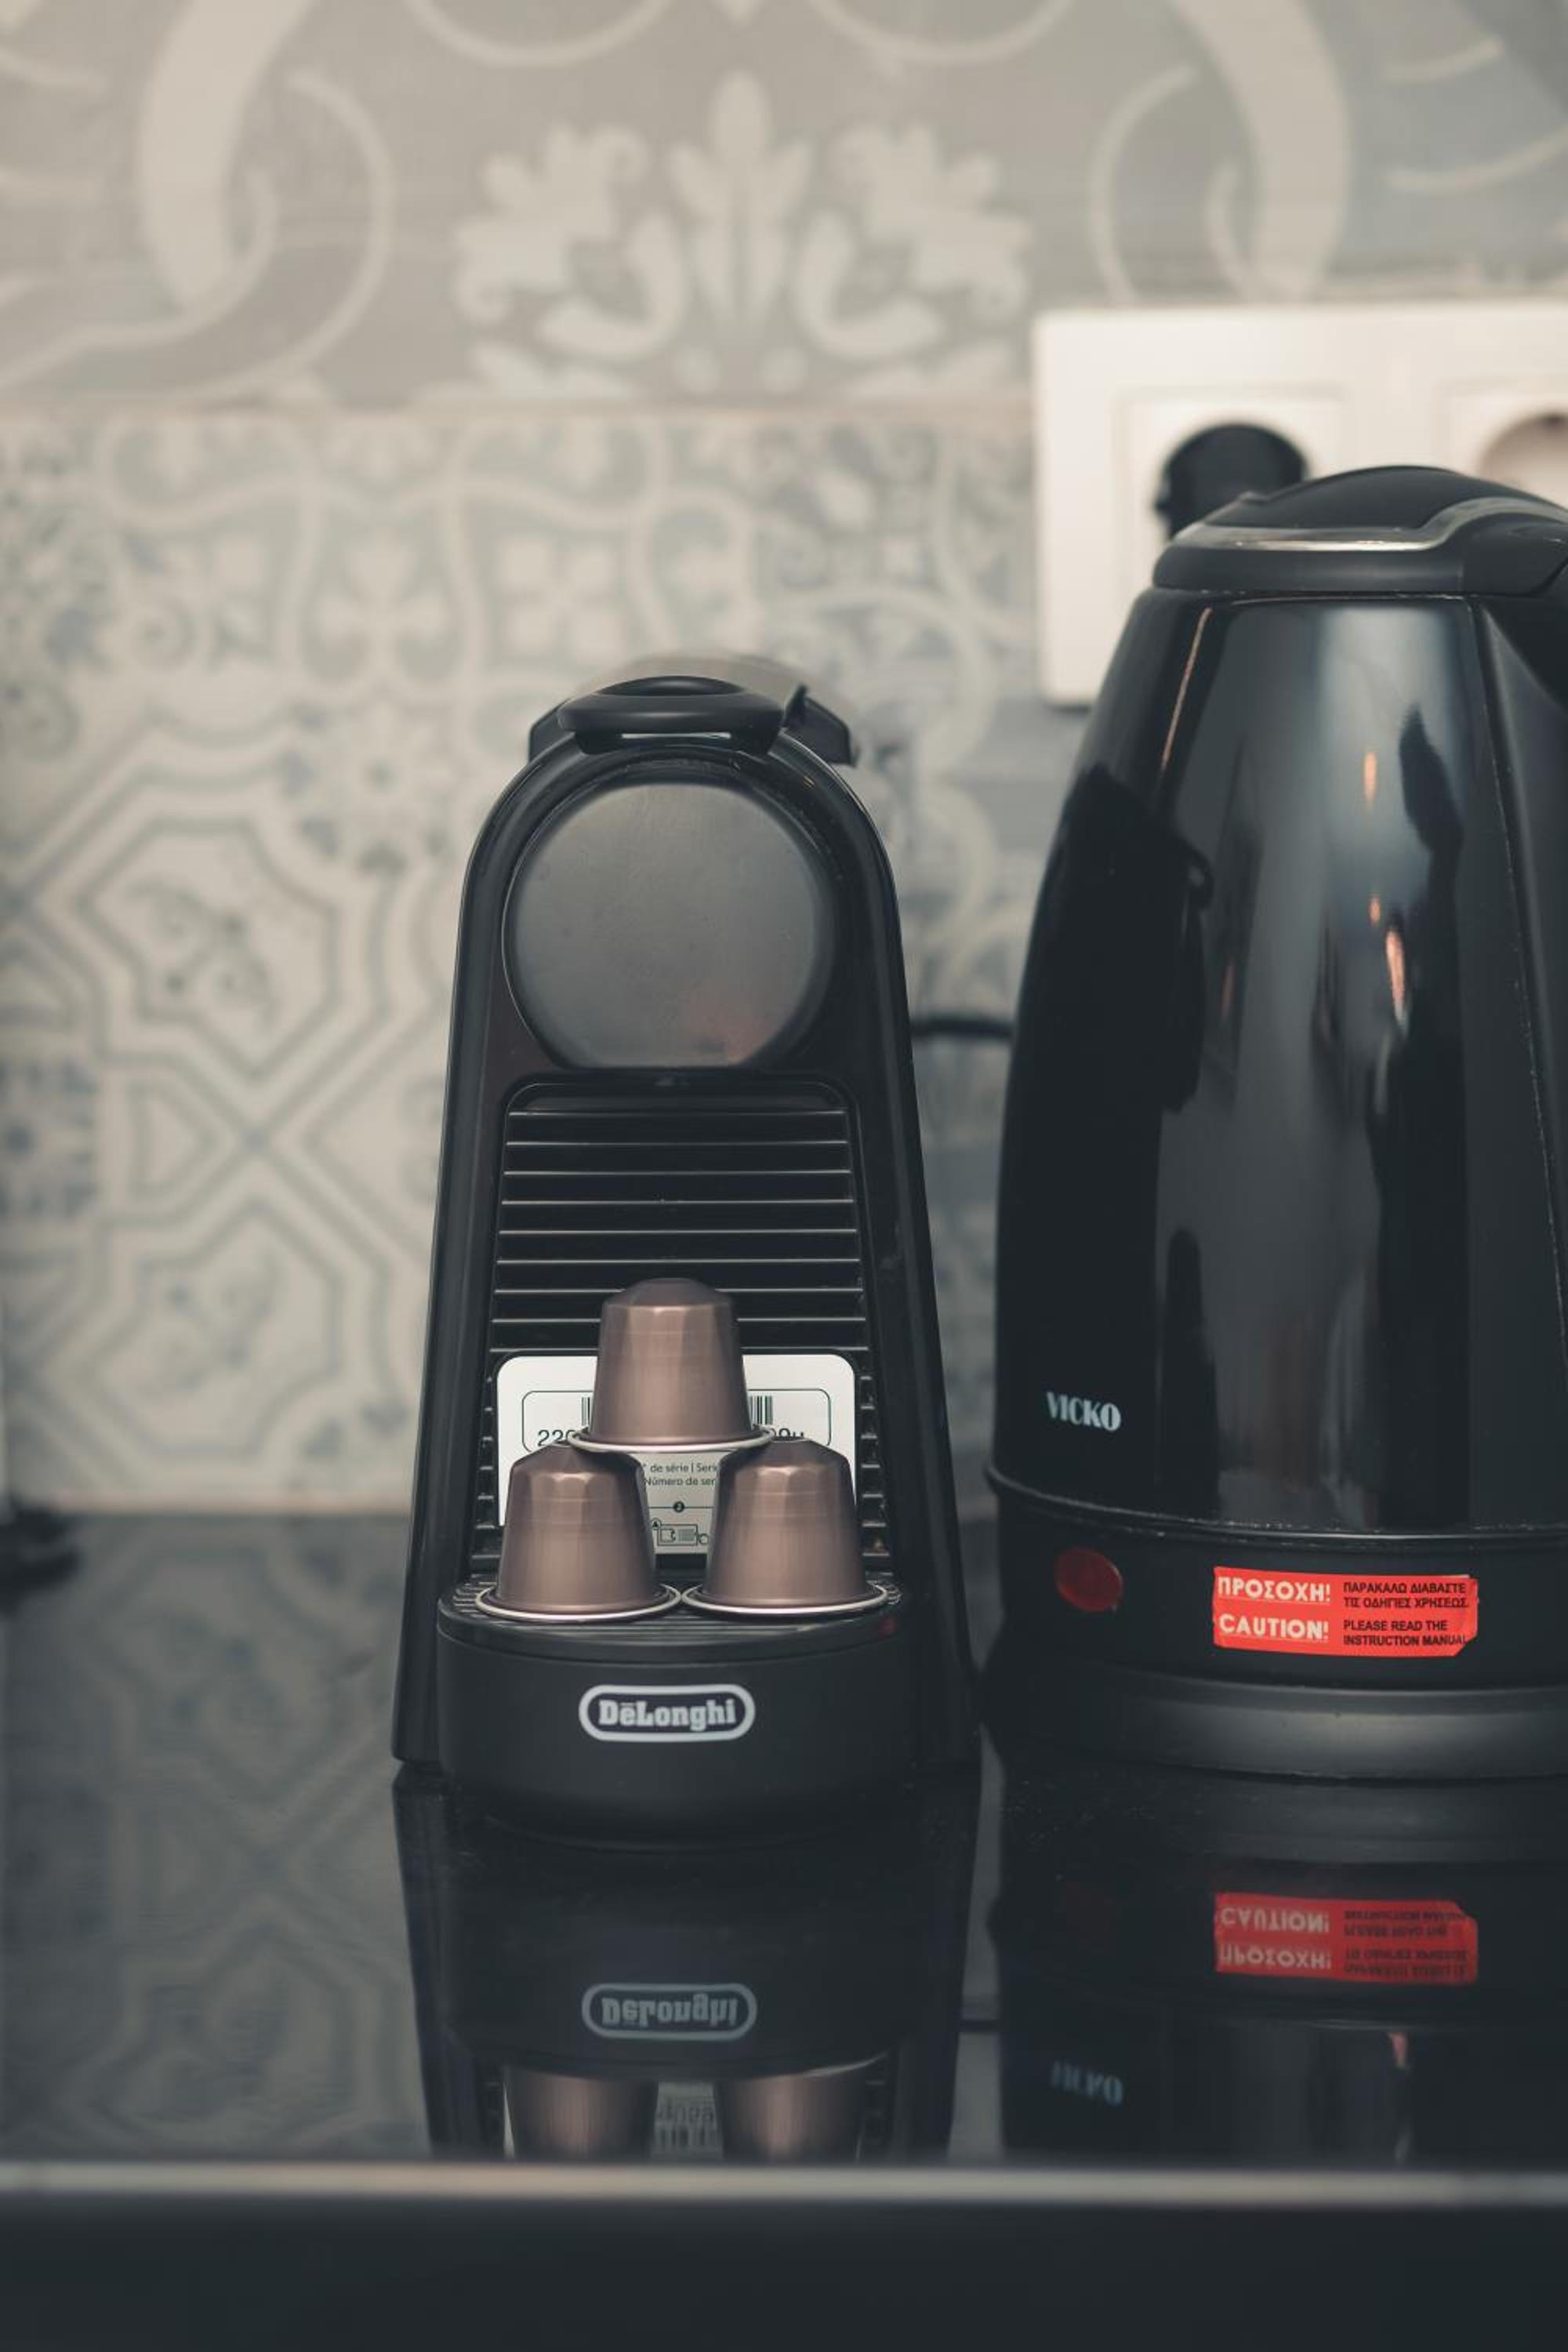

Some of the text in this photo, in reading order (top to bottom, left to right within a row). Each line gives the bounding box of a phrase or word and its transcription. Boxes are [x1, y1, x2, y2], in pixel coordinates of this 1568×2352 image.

[1046, 1391, 1121, 1432] VICKO
[1218, 1576, 1330, 1602] ΠΡΟΣΟΧΗ!
[1343, 1582, 1466, 1594] ΠΑΡΑΚΑΛΩ ΔΙΑΒΑΣΤΕ
[1344, 1597, 1359, 1607] ΤΙΣ
[1219, 1613, 1330, 1640] CAUTION!
[1343, 1620, 1448, 1632] PLEASE READ THE
[1343, 1634, 1419, 1646] INSTRUCTION
